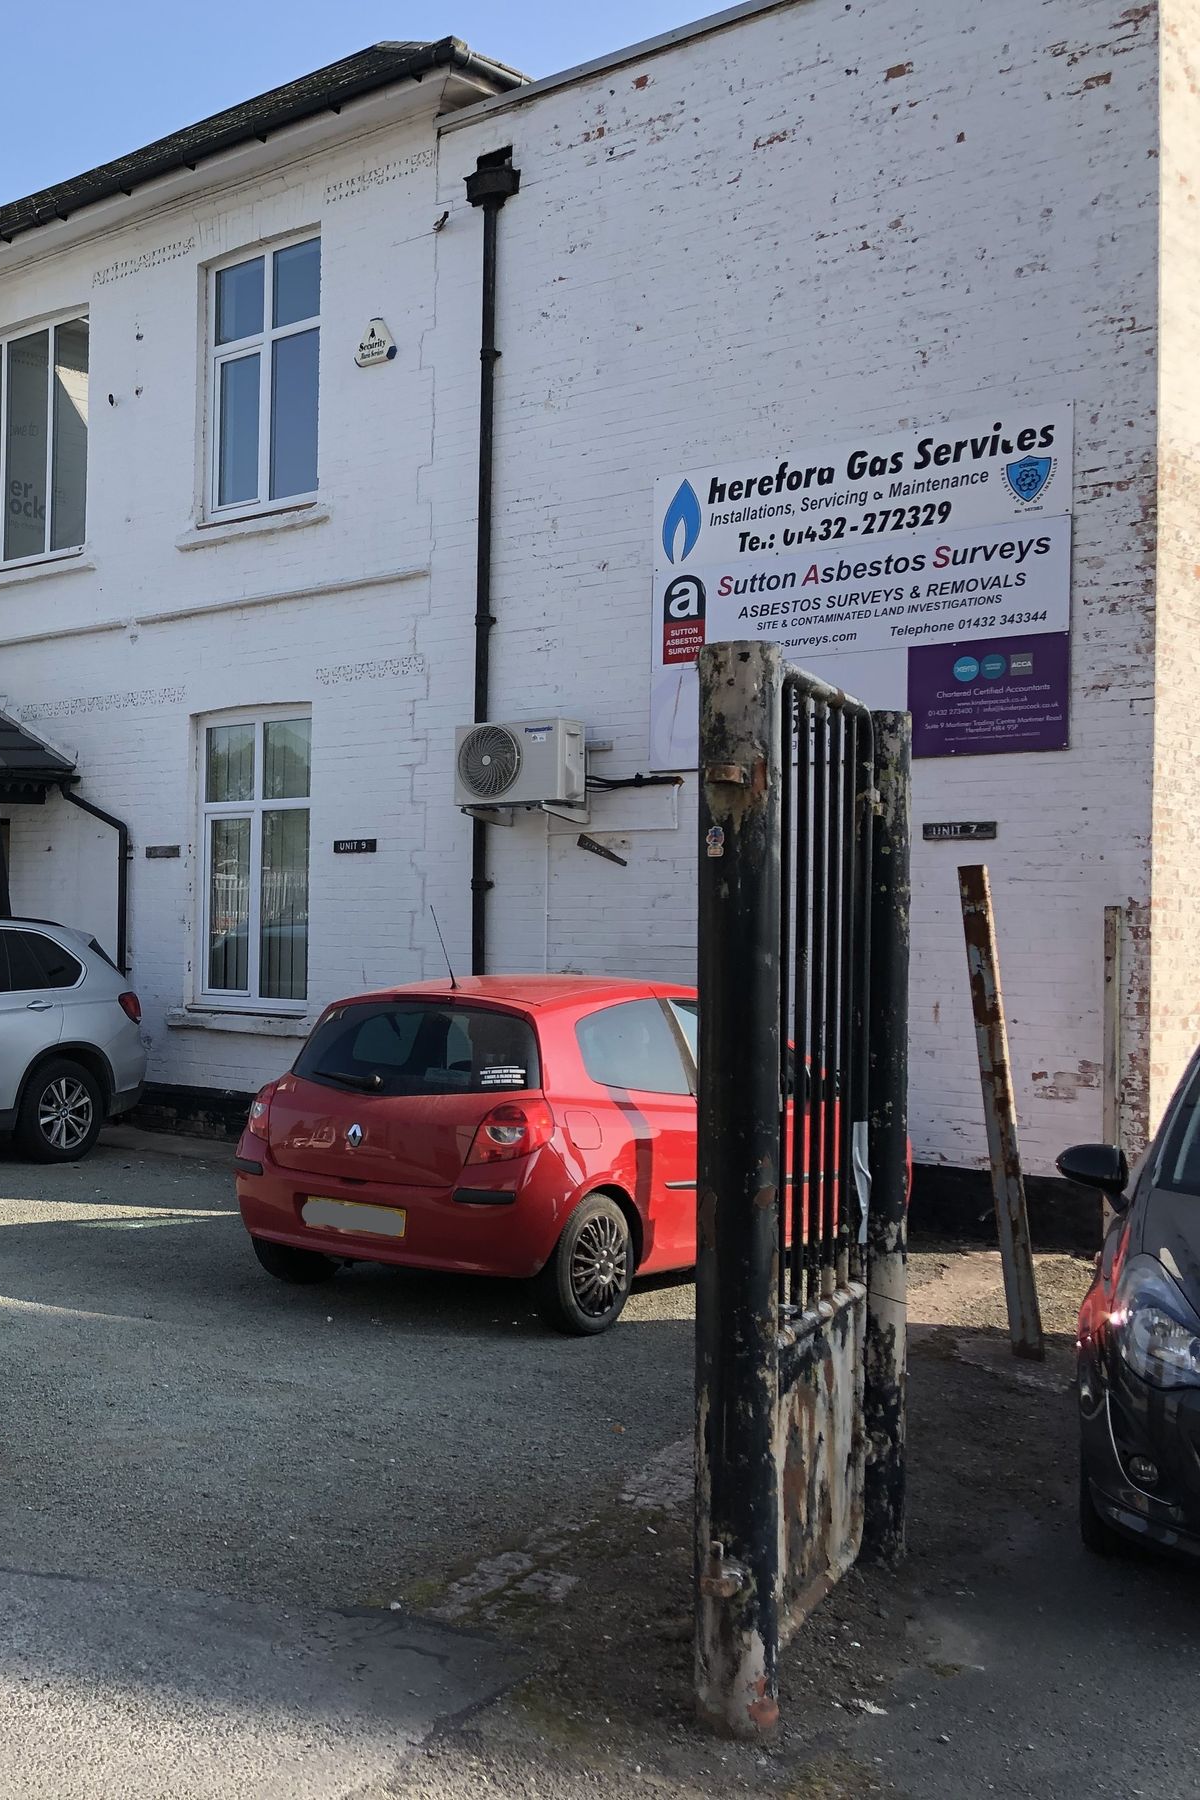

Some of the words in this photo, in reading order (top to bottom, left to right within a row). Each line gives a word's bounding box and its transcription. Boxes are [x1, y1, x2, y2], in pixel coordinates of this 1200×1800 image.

[846, 450, 904, 482] Gas
[709, 502, 796, 527] Installations,
[800, 490, 869, 512] Servicing
[888, 471, 989, 498] Maintenance
[717, 572, 797, 597] Sutton
[801, 554, 927, 587] Asbestos
[932, 536, 1052, 569] Surveys
[738, 598, 821, 619] ASBESTOS
[826, 587, 904, 609] SURVEYS
[910, 585, 921, 599] &
[926, 572, 1027, 597] REMOVALS
[756, 621, 779, 631] SITE
[781, 620, 788, 628] &
[791, 610, 872, 627] CONTAMINATED
[874, 606, 904, 618] LAND
[907, 594, 1003, 614] INVESTIGATIONS
[670, 627, 699, 637] SUTTON
[776, 632, 857, 648] -surveys.com
[890, 620, 955, 637] Telephone
[957, 616, 996, 631] 01432
[999, 610, 1047, 626] 343344
[666, 636, 703, 647] ASBESTOS
[1011, 660, 1032, 668] ACCA
[936, 689, 972, 699] Chartered
[973, 686, 1004, 696] Certified
[1005, 684, 1051, 693] Accountants
[932, 825, 961, 836] UNIT
[969, 824, 977, 833] 7
[339, 841, 358, 850] UNIT
[361, 841, 367, 849] 9
